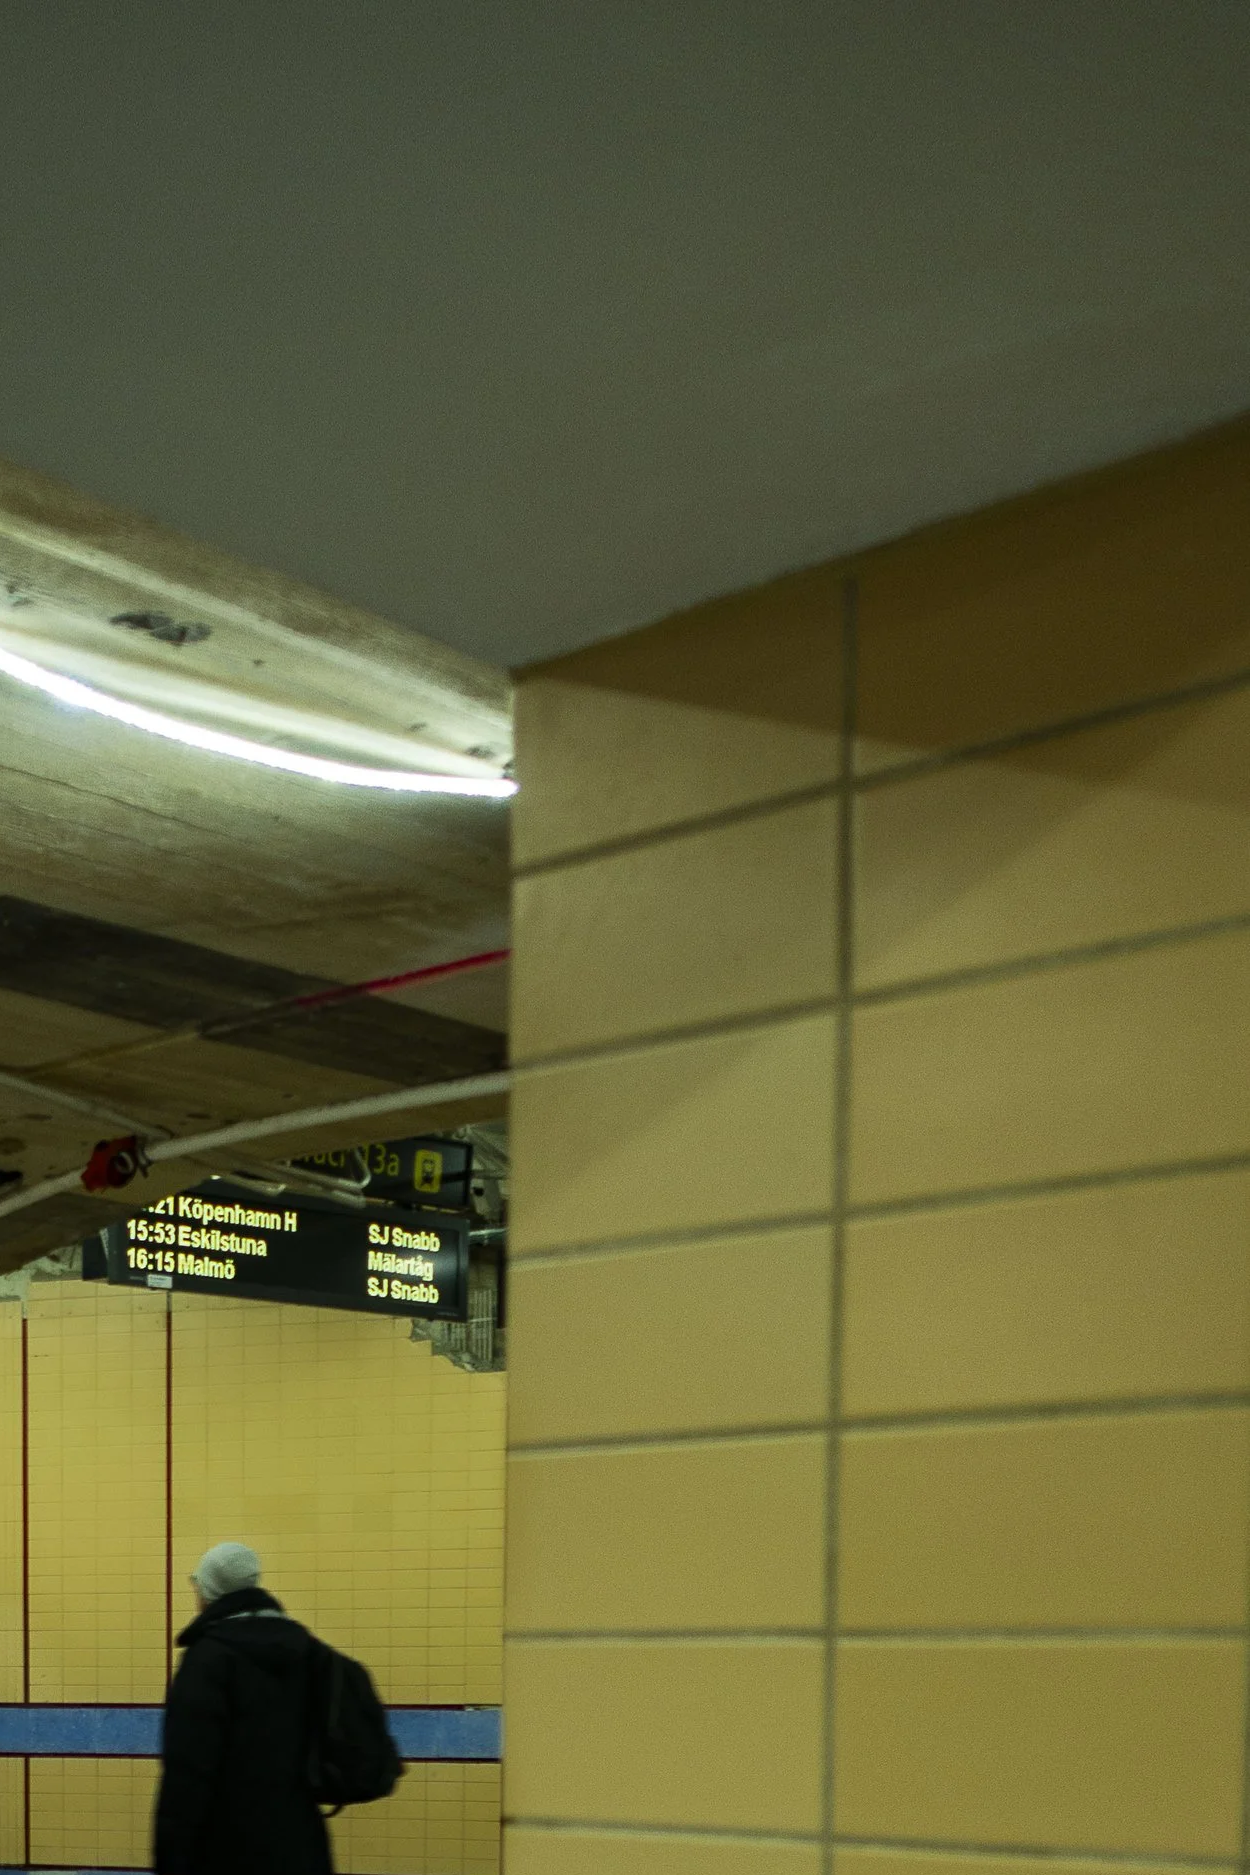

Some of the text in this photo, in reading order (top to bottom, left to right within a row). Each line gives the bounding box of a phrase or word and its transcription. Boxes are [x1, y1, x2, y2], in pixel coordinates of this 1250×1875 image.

[127, 1219, 434, 1281] 15:53 Eskilstuna Mälartåg
[178, 1196, 281, 1230] Köpenhamn
[284, 1211, 297, 1232] H
[369, 1224, 390, 1245] SJ
[392, 1227, 440, 1252] Snabb
[127, 1247, 439, 1304] 16:15 Malmö SJ Snabb
